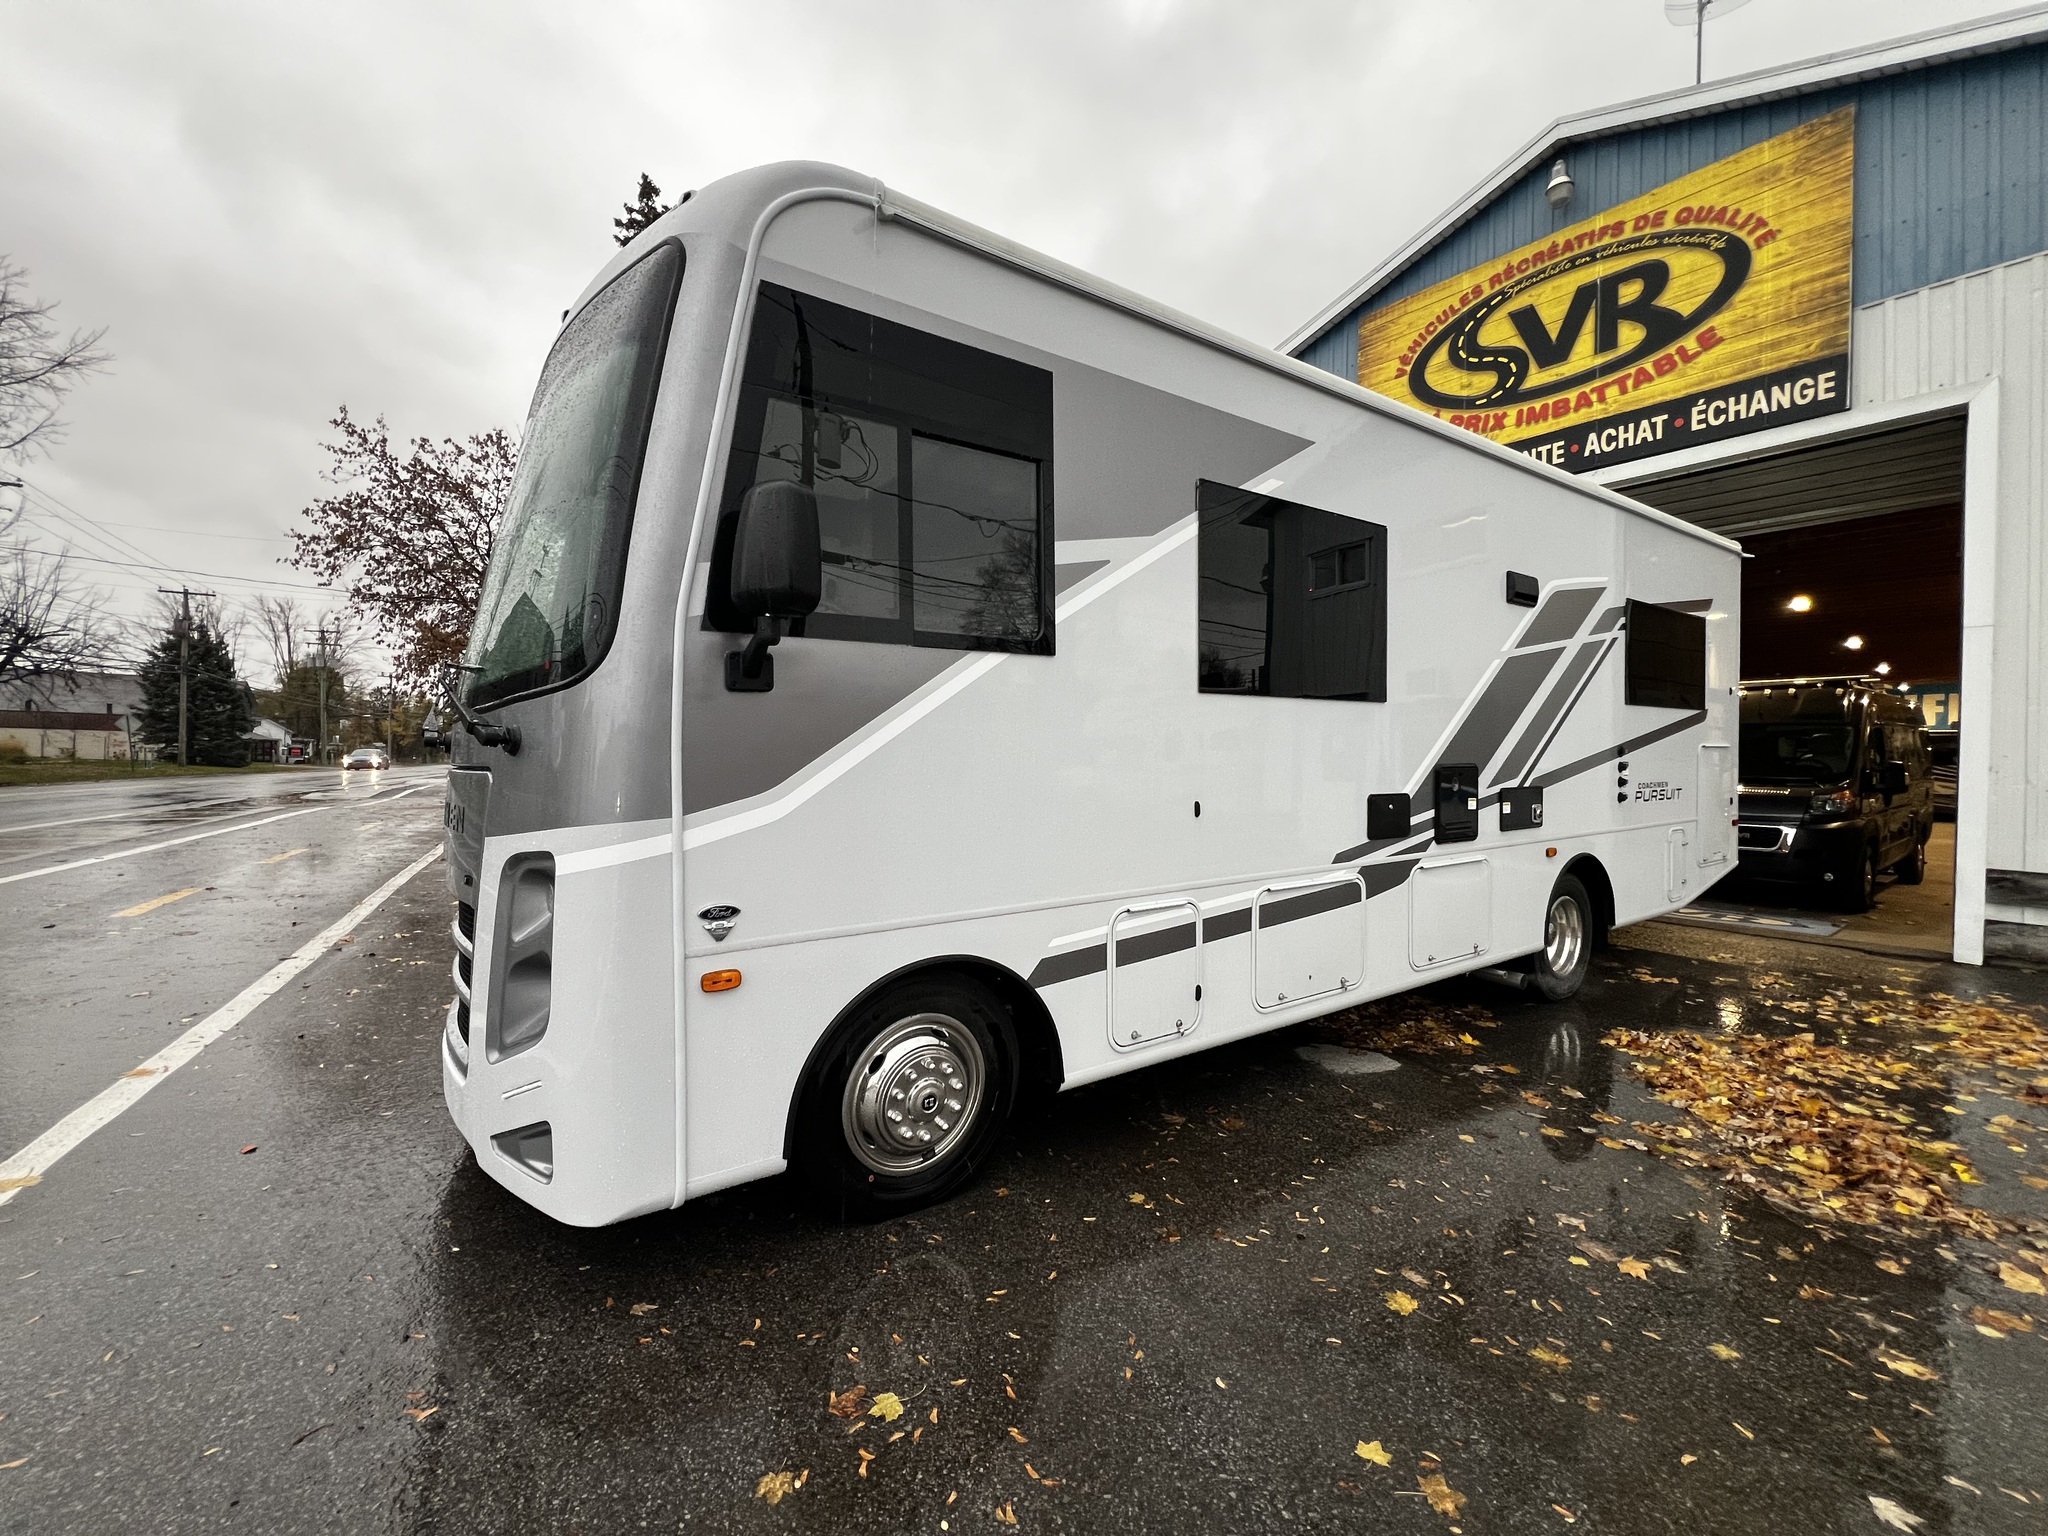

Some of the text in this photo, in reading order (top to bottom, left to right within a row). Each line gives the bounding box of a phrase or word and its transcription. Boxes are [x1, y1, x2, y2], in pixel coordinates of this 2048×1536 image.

[1489, 220, 1626, 290] RÉCRÉATIFS
[1632, 209, 1668, 233] DE
[1674, 205, 1782, 249] QUALITÉ
[1575, 256, 1593, 266] en
[1596, 234, 1660, 259] véhicules
[1447, 257, 1694, 407] SVR
[1450, 325, 1724, 434] PRIX IMBATTABLE
[1583, 414, 1669, 457] ACHAT
[1690, 370, 1836, 432] ÉCHANGE
[1634, 788, 1683, 804] PURSUIT
[707, 906, 733, 919] Ford
